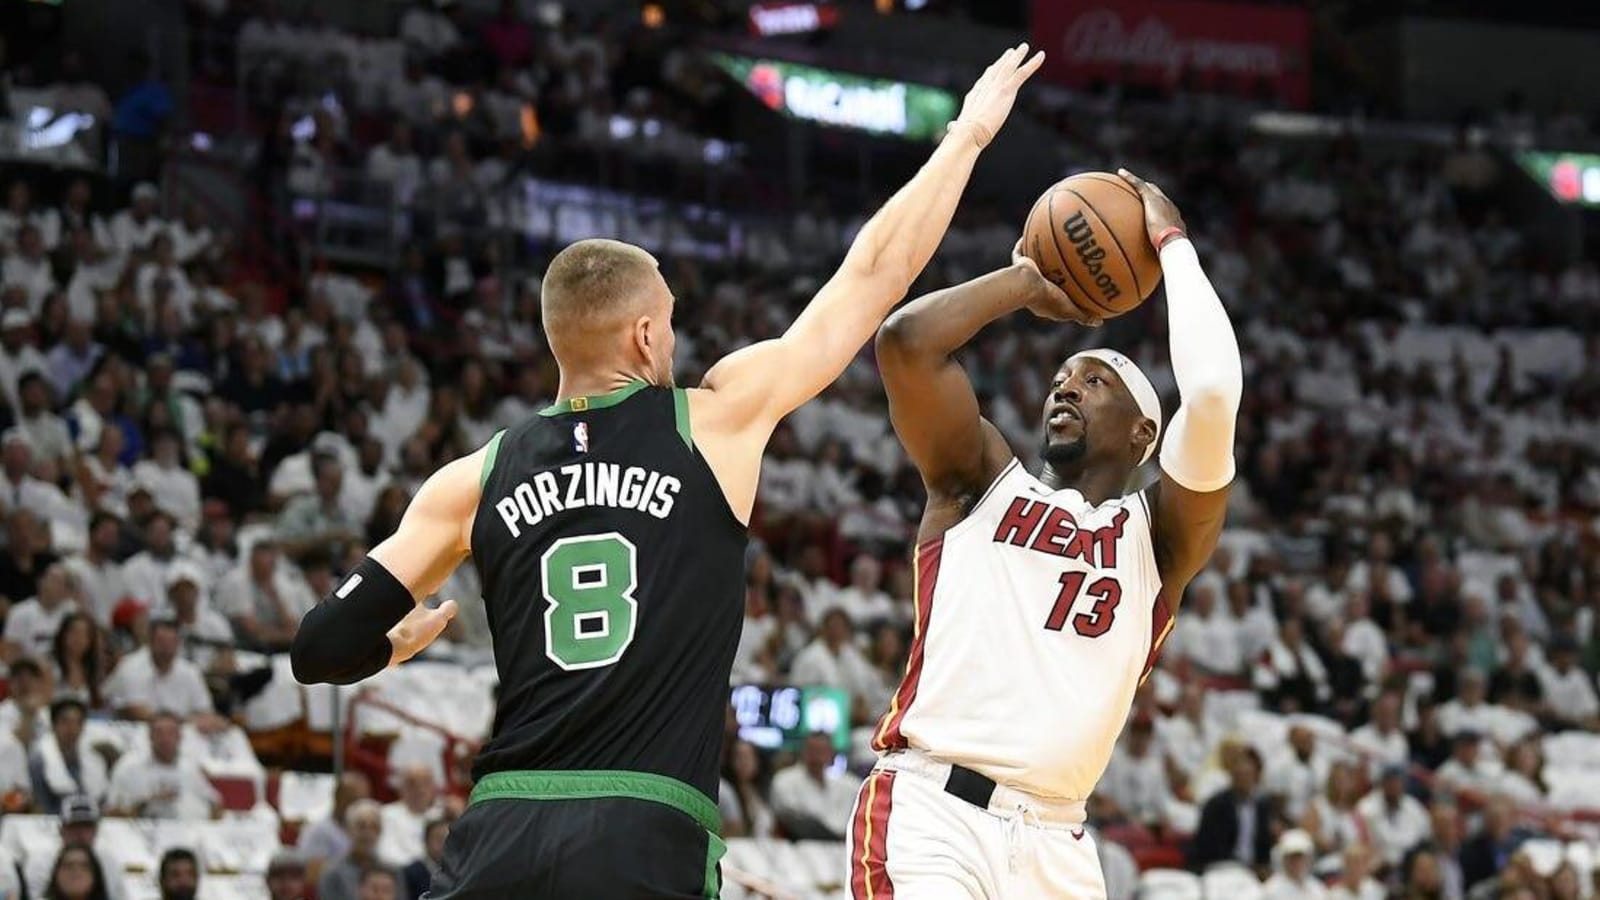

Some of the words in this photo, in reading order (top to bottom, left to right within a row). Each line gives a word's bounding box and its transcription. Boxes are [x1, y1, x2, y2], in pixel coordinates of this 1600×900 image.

[1063, 210, 1122, 302] Wilson
[496, 462, 681, 538] PORZINGIS
[993, 496, 1130, 569] HEAT
[541, 532, 638, 671] 8
[1044, 571, 1123, 638] 13
